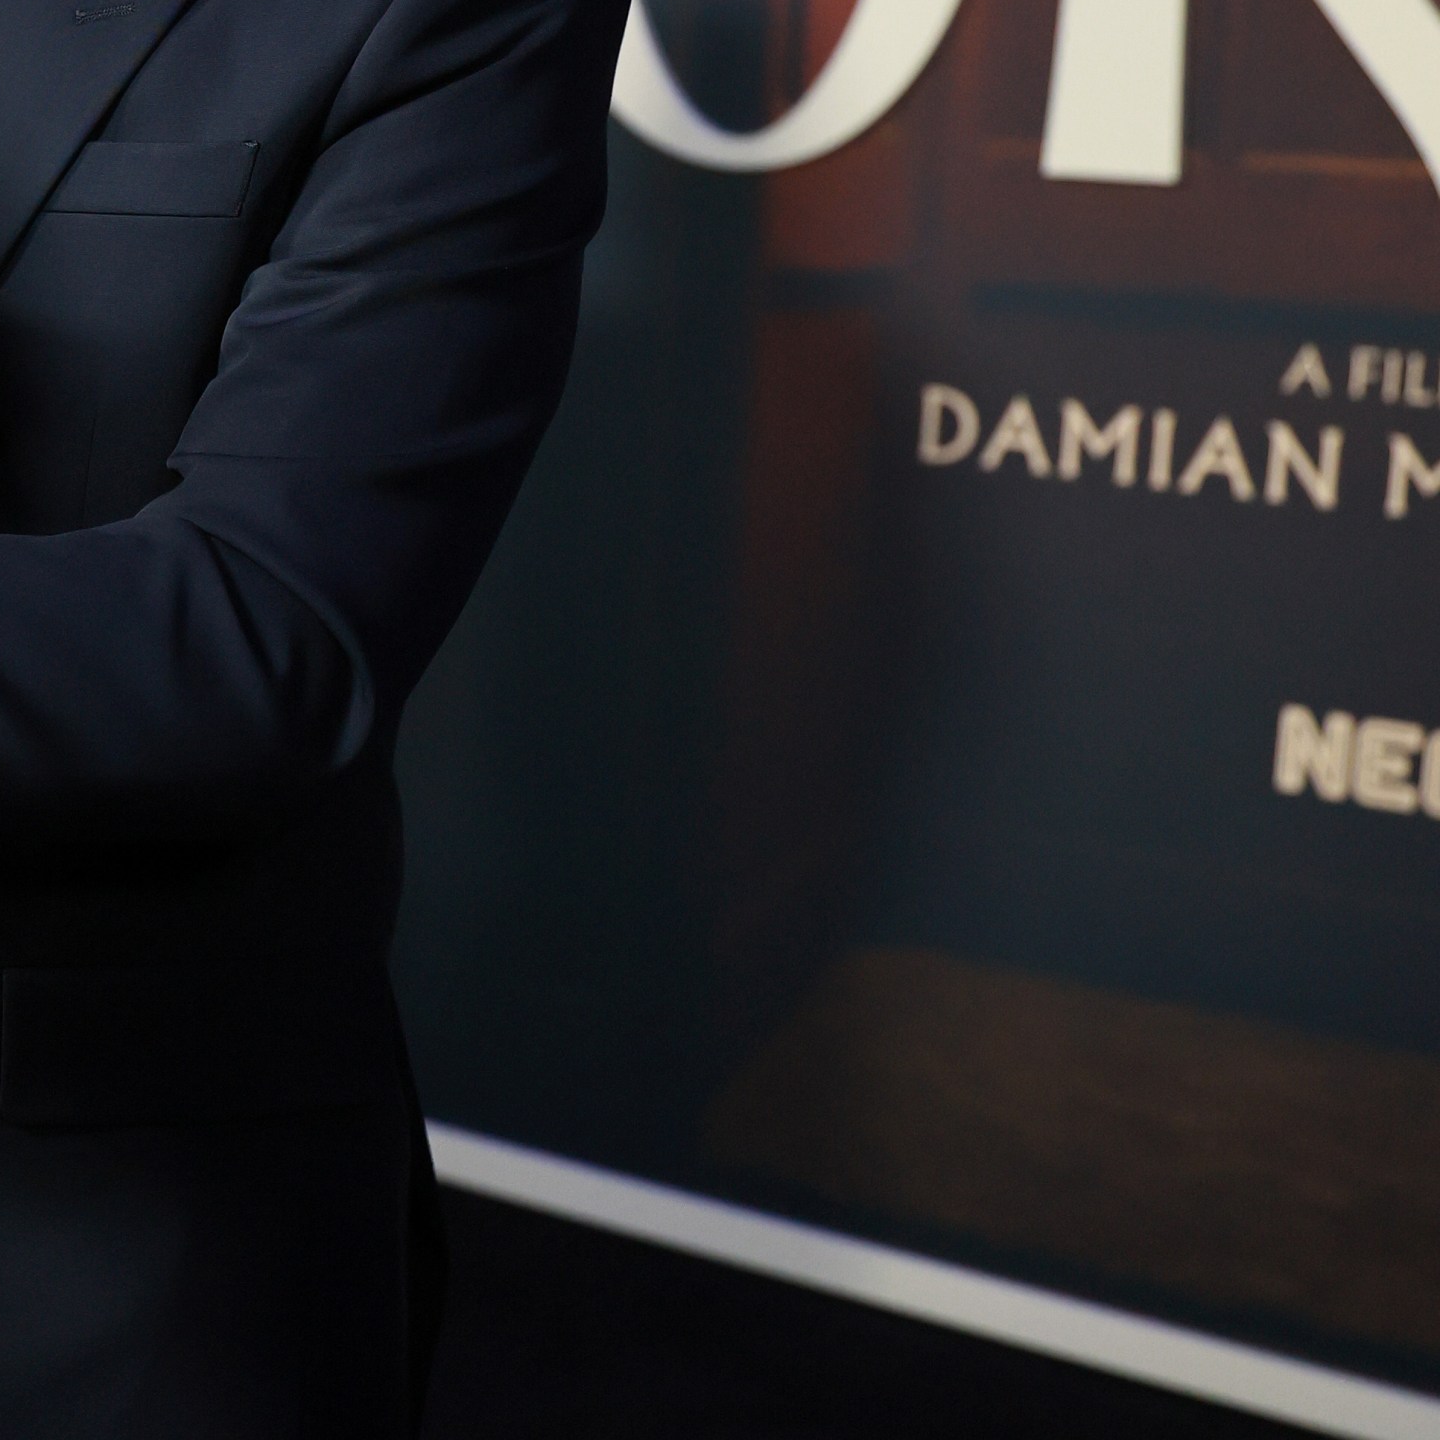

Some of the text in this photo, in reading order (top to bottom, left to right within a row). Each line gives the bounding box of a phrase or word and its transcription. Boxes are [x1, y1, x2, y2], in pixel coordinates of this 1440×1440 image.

[1279, 343, 1440, 409] A FIL
[918, 382, 1345, 513] DAMIAN
